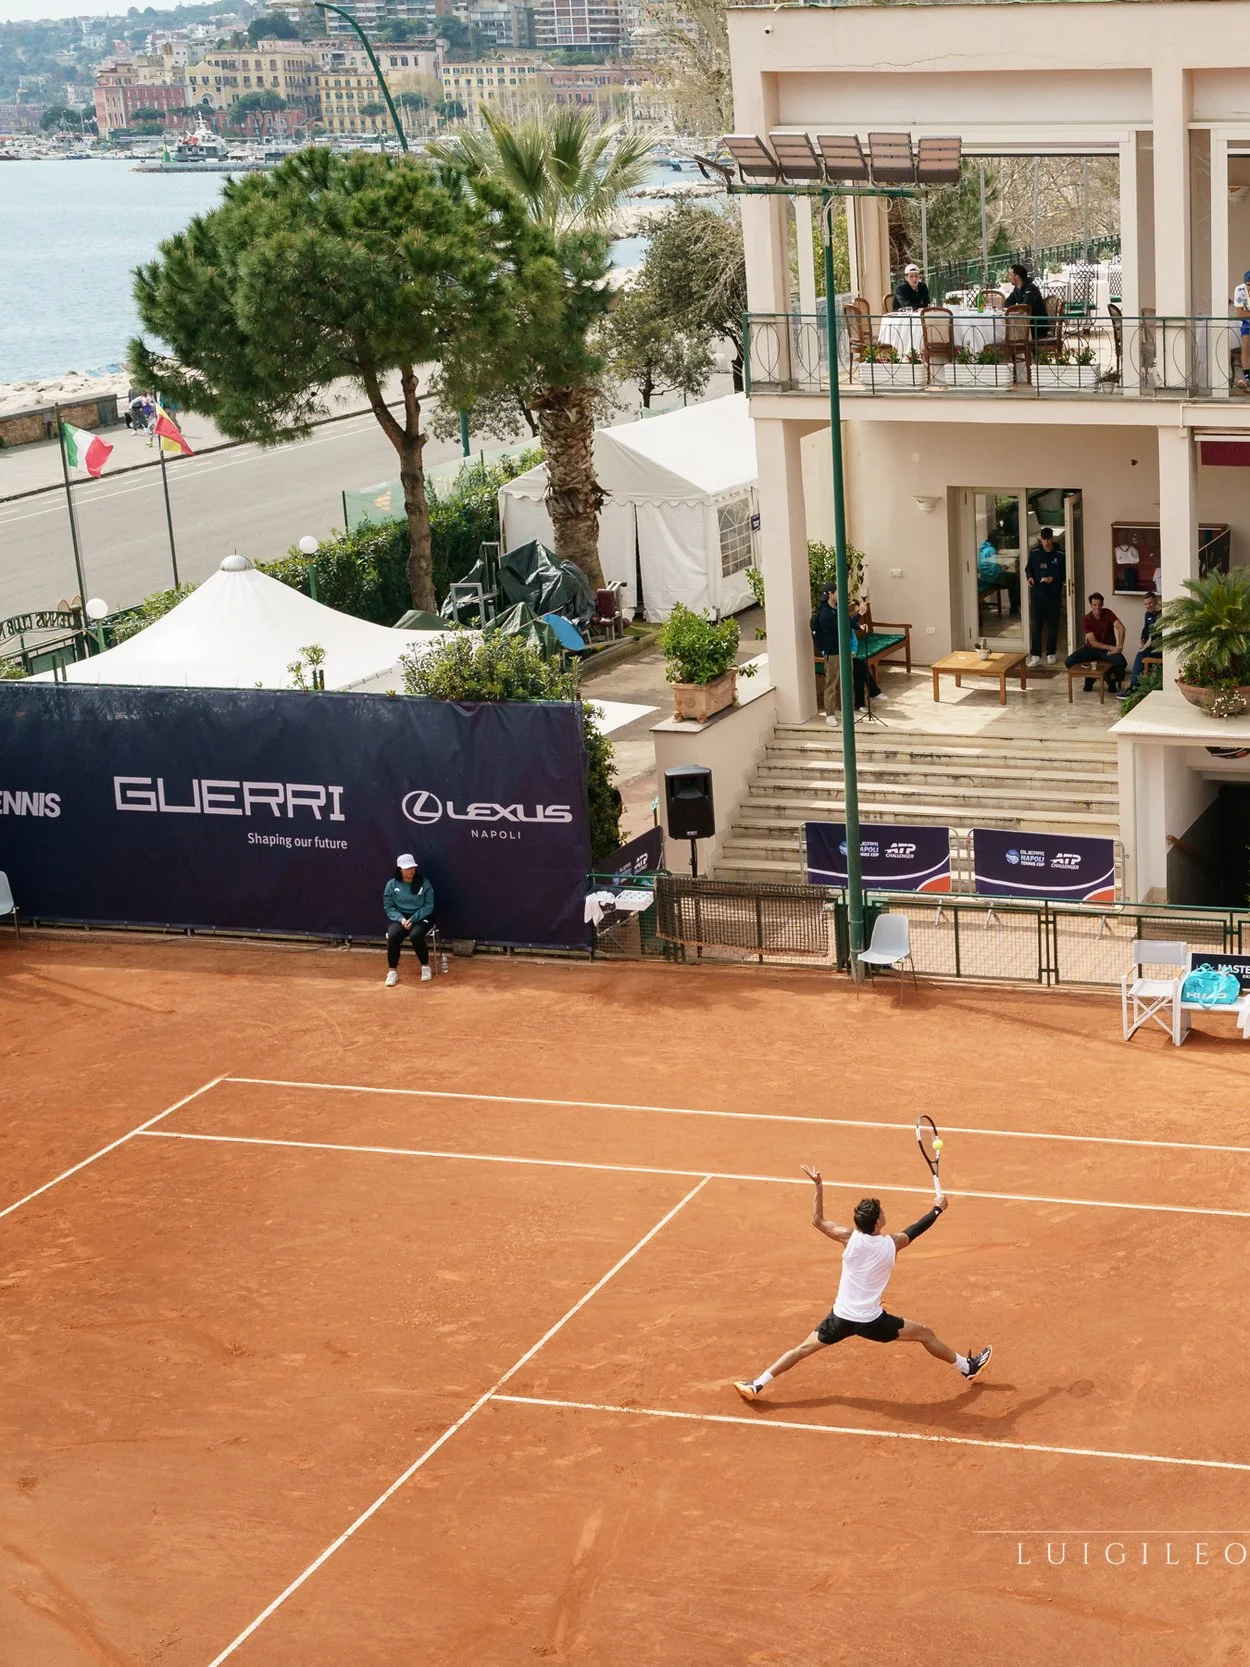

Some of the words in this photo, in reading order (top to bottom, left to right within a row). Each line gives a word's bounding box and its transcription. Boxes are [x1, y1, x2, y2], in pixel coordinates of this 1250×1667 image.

[0, 790, 61, 818] NNIS
[113, 776, 345, 821] GUERRI
[446, 801, 573, 823] LEXUS
[247, 832, 292, 848] Shaping
[294, 838, 312, 847] our
[314, 836, 348, 849] future
[471, 829, 521, 839] NAPOLI
[884, 843, 917, 854] ATP
[1050, 853, 1082, 865] ATP
